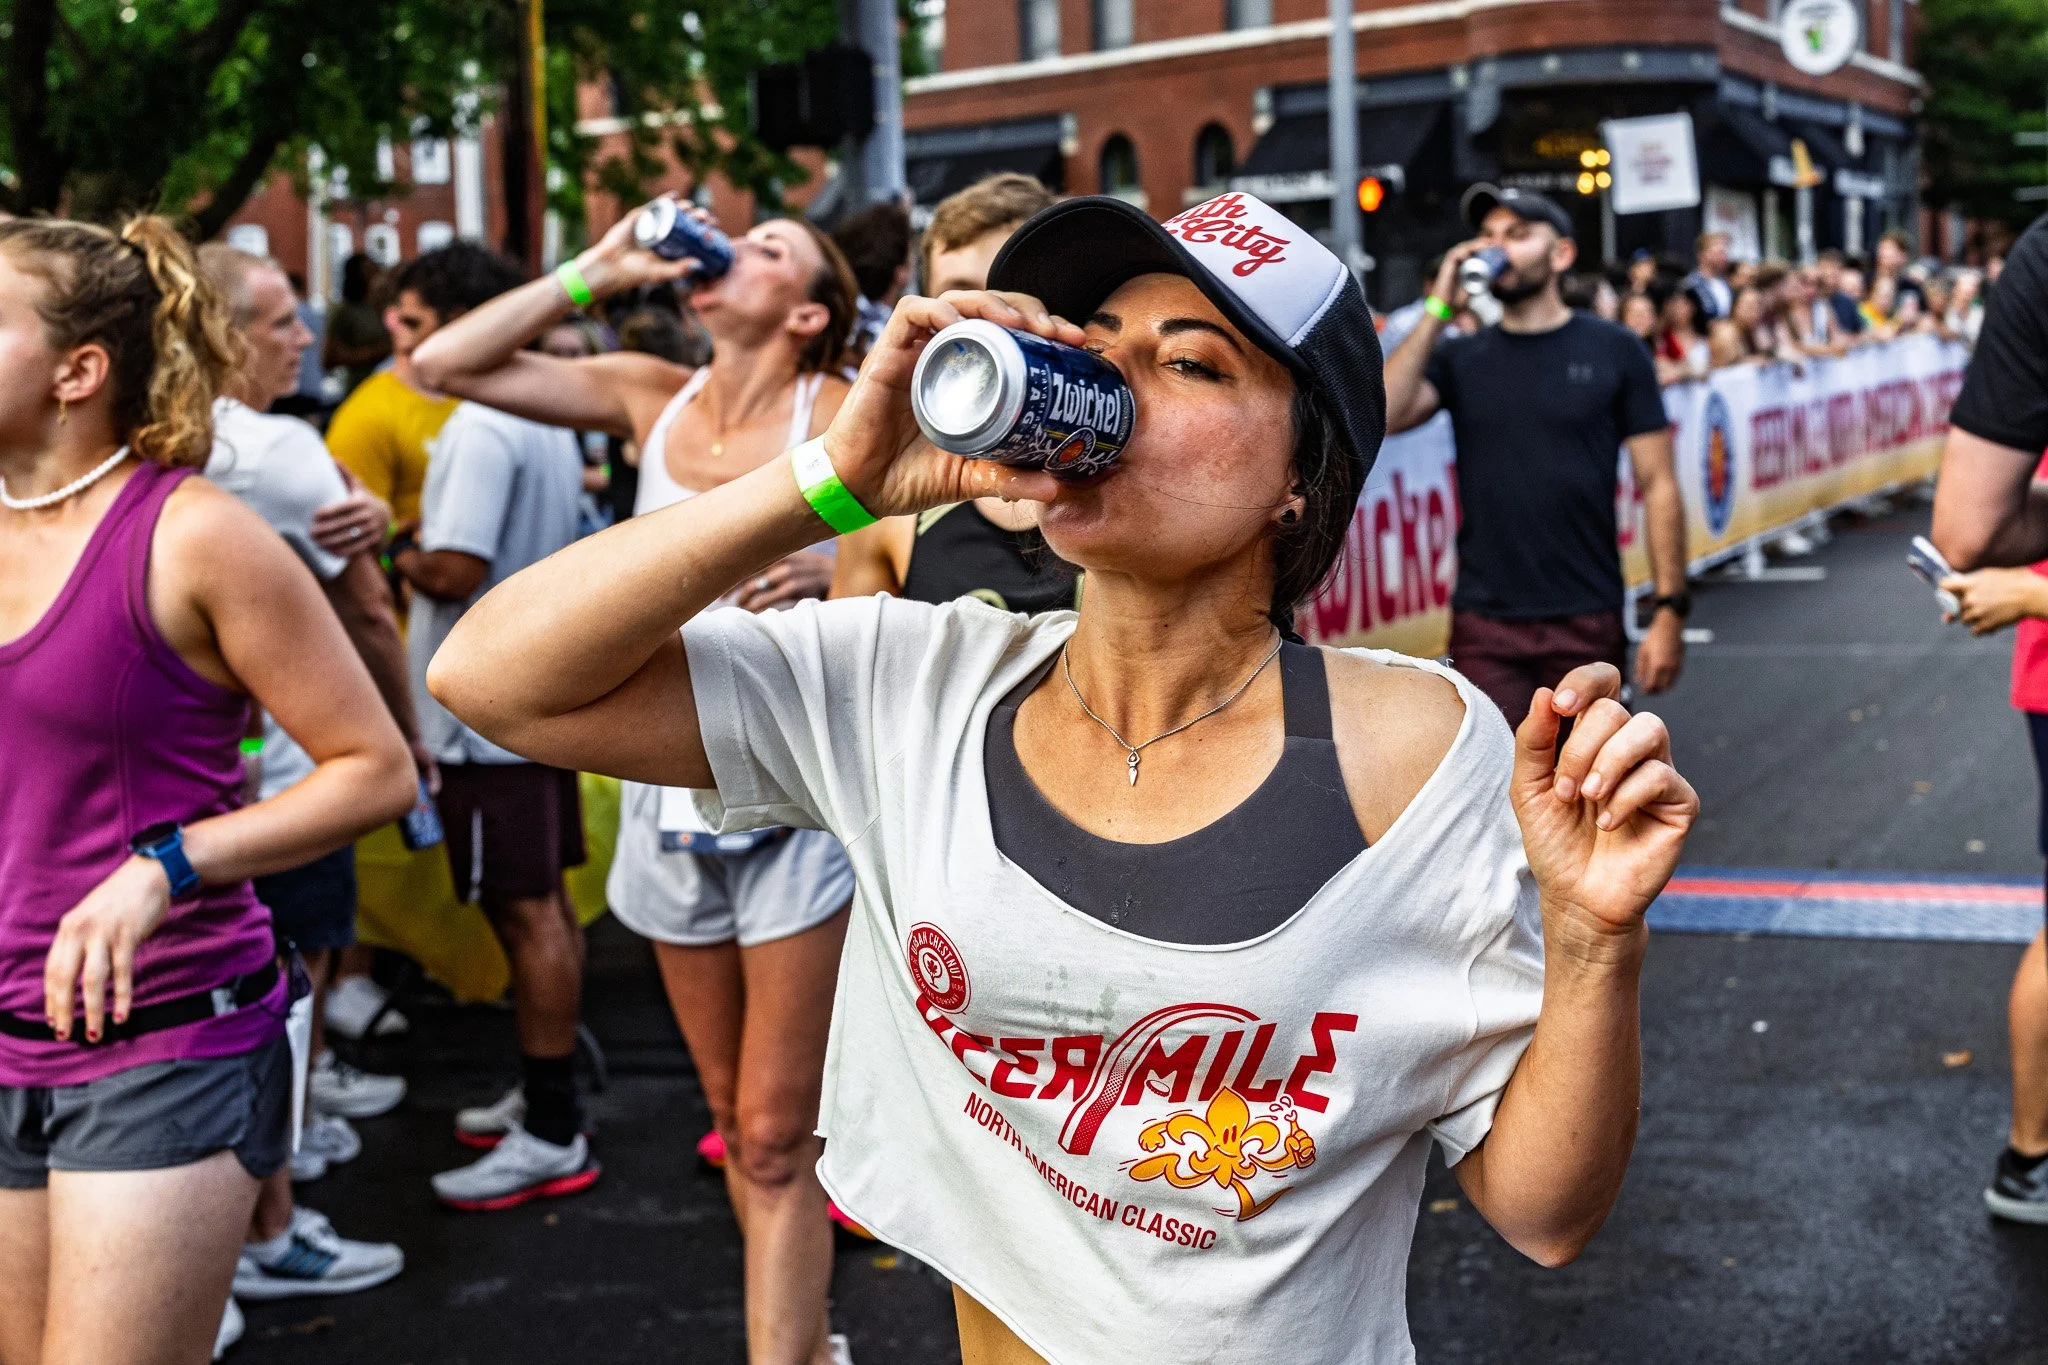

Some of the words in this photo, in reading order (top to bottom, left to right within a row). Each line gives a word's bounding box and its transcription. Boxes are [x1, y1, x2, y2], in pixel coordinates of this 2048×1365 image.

[1181, 219, 1291, 277] City
[1049, 372, 1120, 435] Zwickel
[1300, 462, 1463, 641] wicke
[929, 932, 962, 981] CHESTNUT
[1121, 1012, 1358, 1113] MILE
[964, 1092, 1022, 1151] NORTH
[1024, 1145, 1119, 1221] AMERICAN
[1121, 1204, 1217, 1250] CLASSIC
